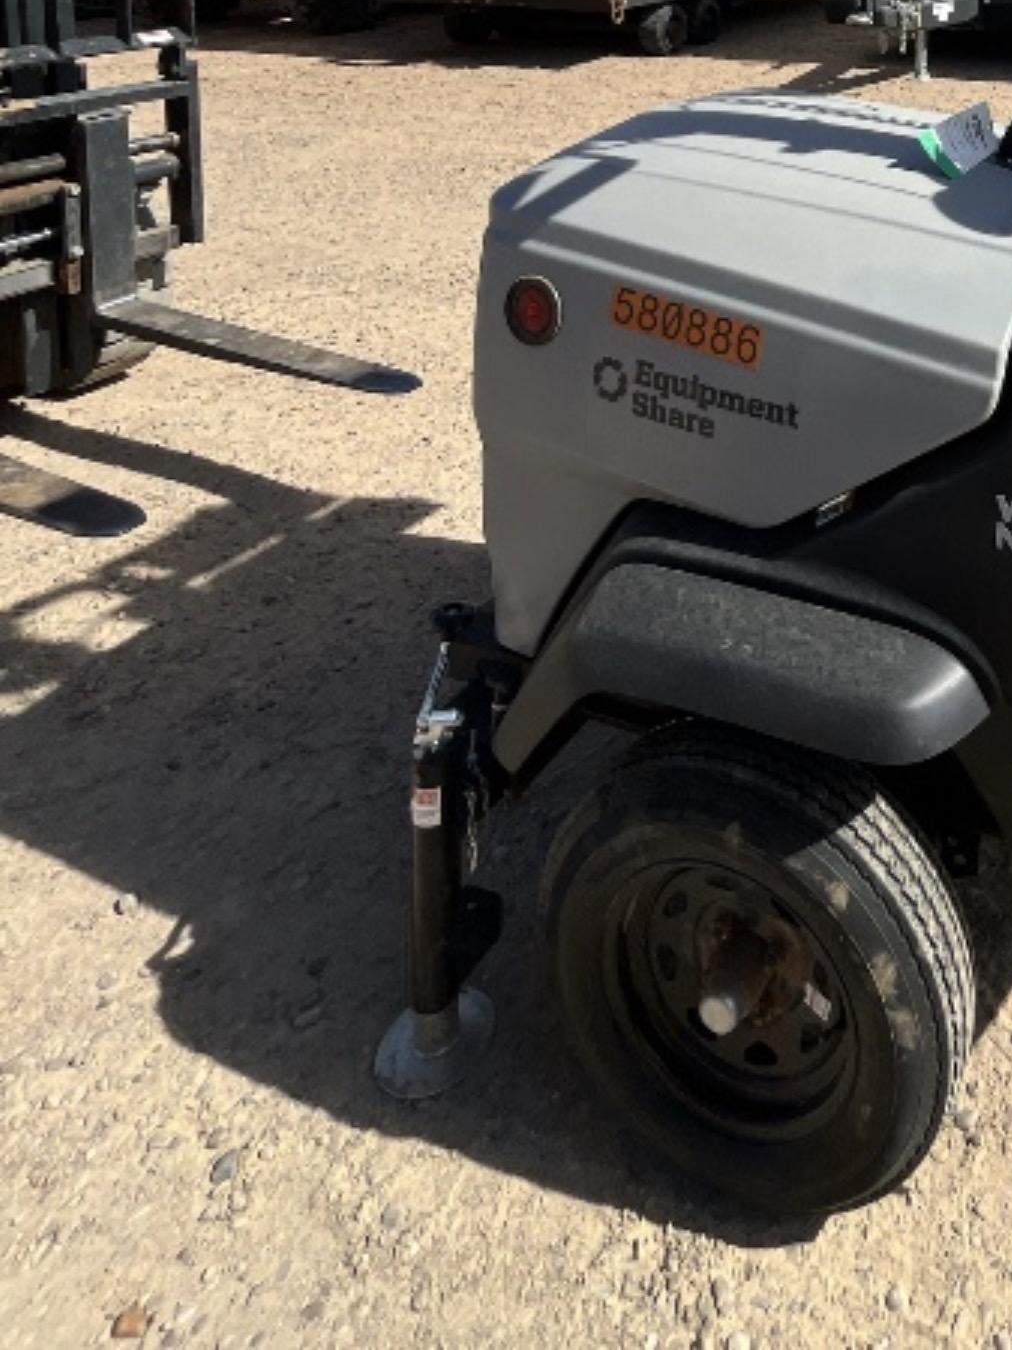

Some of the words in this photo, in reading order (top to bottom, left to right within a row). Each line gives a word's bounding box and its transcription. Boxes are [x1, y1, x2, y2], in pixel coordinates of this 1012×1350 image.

[613, 287, 761, 364] 580886
[631, 390, 715, 439] Share
[634, 359, 801, 430] Equipment
